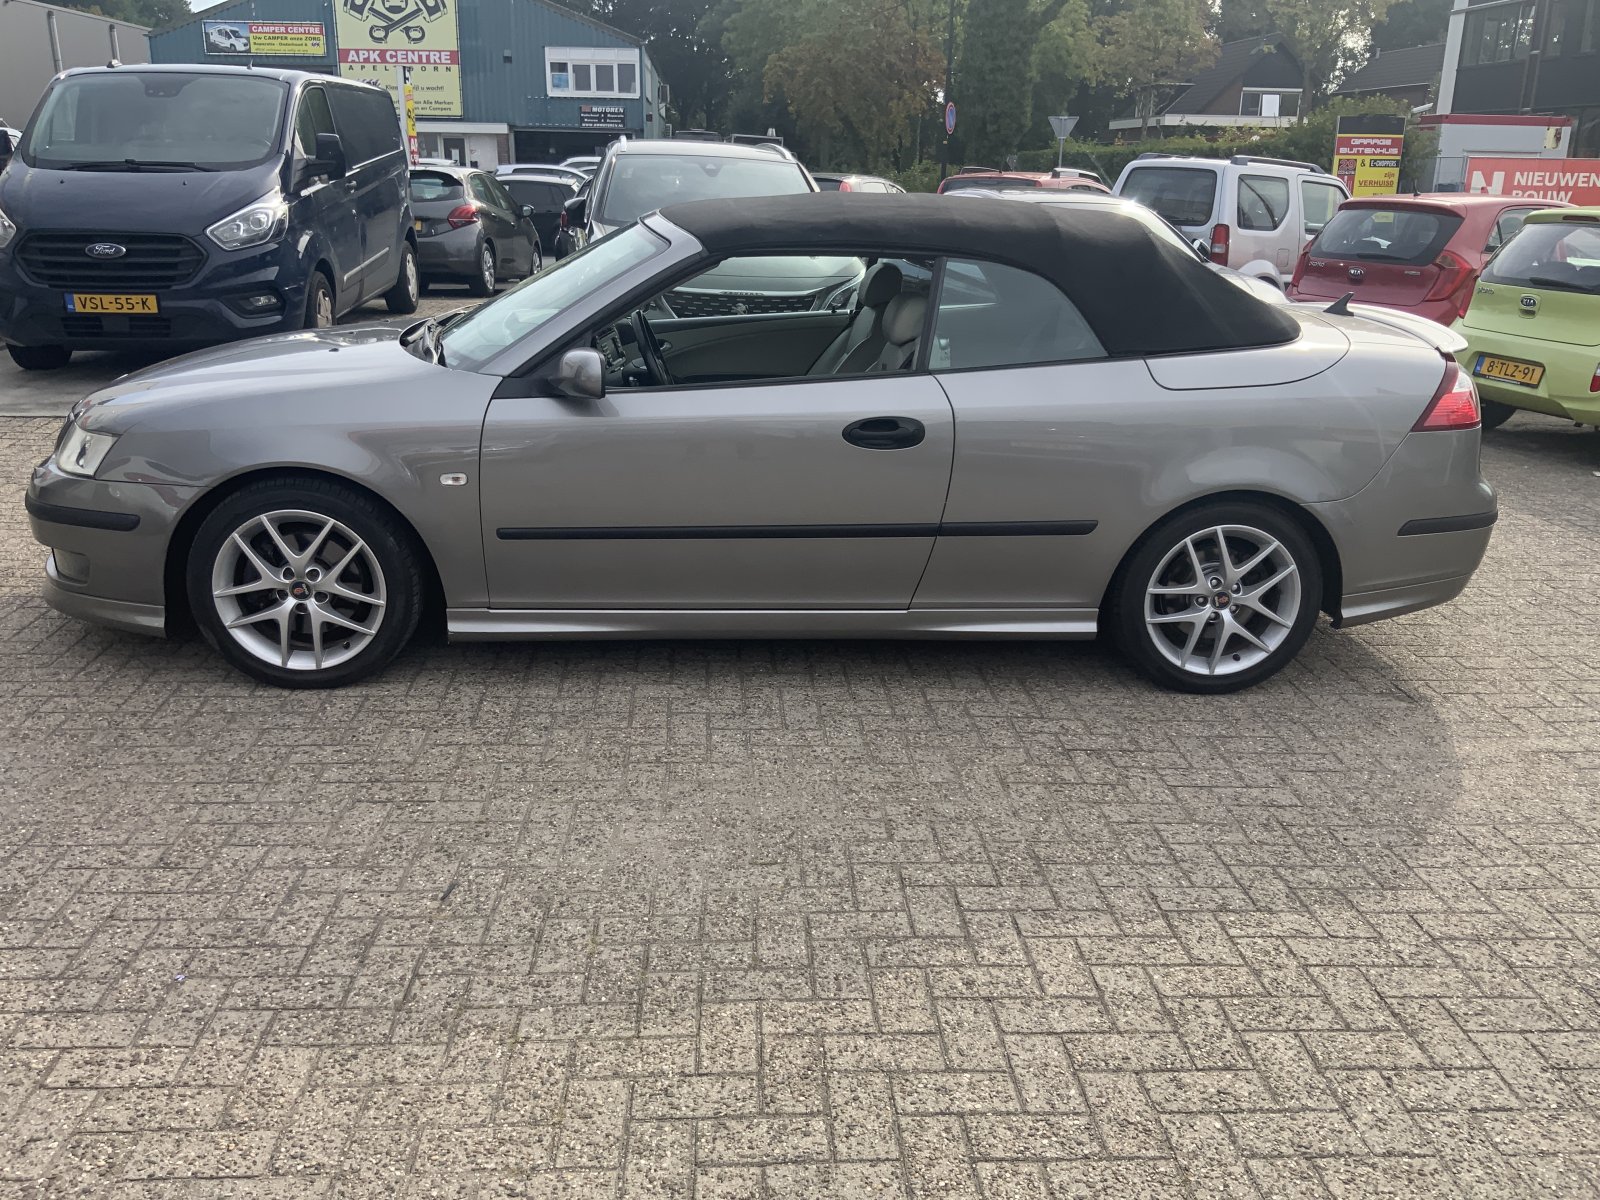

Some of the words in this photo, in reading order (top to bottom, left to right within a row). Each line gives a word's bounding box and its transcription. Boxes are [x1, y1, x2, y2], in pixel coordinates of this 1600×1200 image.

[347, 50, 382, 63] APK
[385, 51, 451, 64] CENTRE
[1360, 159, 1366, 167] &
[93, 244, 116, 255] Ford
[78, 296, 151, 310] VSL-55-K
[1486, 360, 1536, 381] 8-TLZ-91
